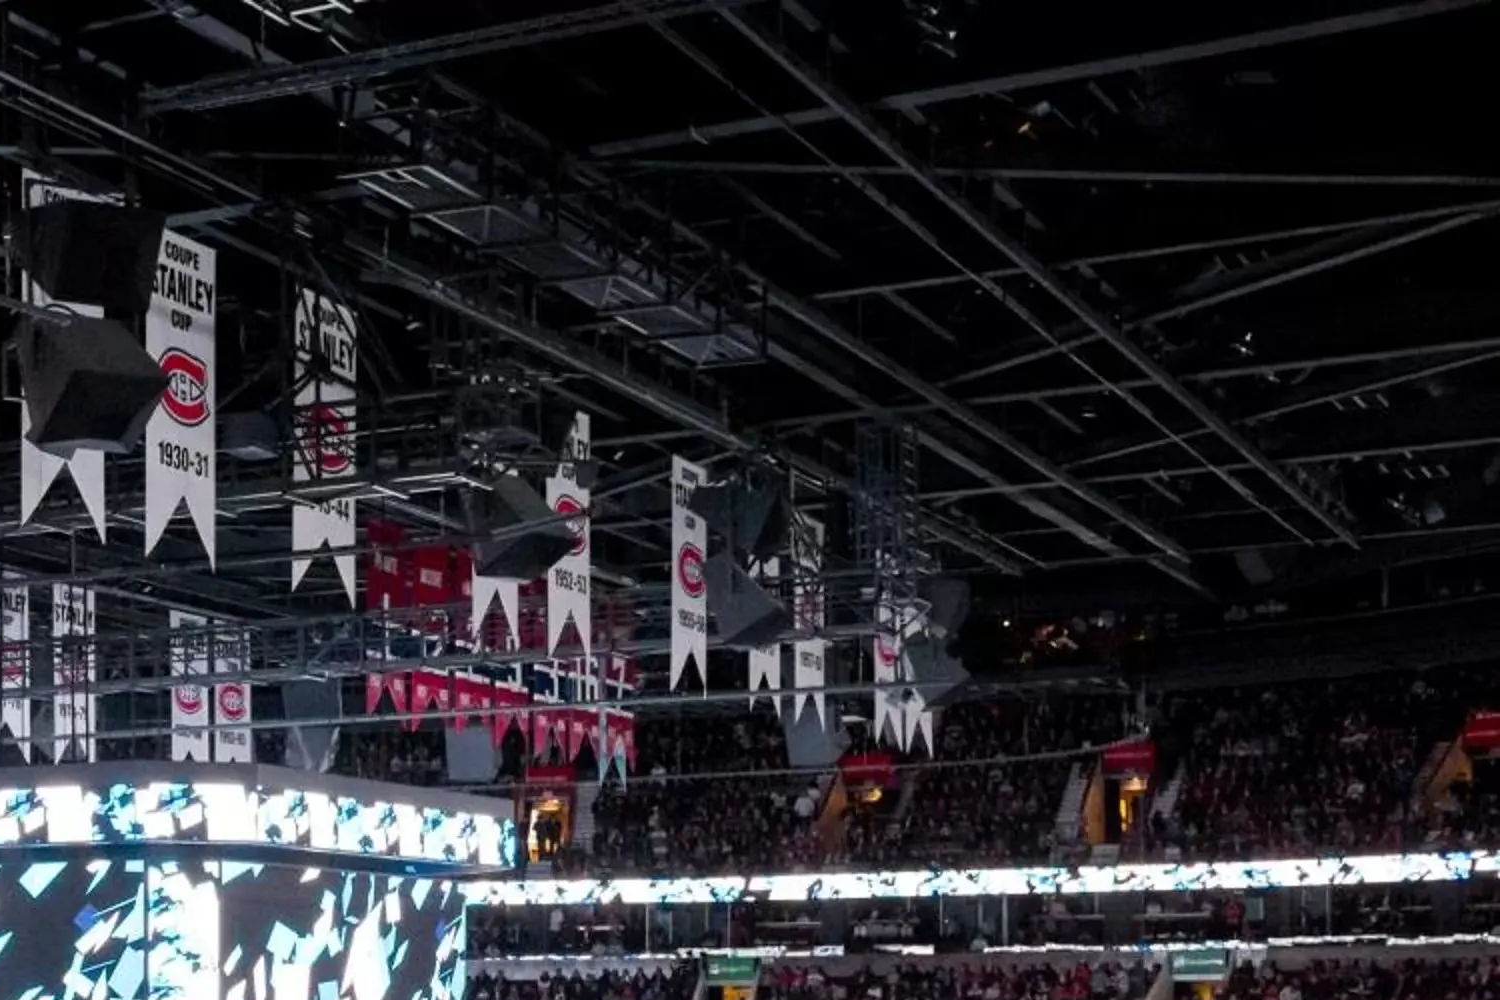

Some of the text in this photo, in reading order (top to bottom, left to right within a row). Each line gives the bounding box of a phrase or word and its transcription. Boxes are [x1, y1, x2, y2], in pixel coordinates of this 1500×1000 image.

[164, 240, 199, 270] COUPE
[171, 308, 193, 332] CUP
[158, 441, 209, 479] 1930-31
